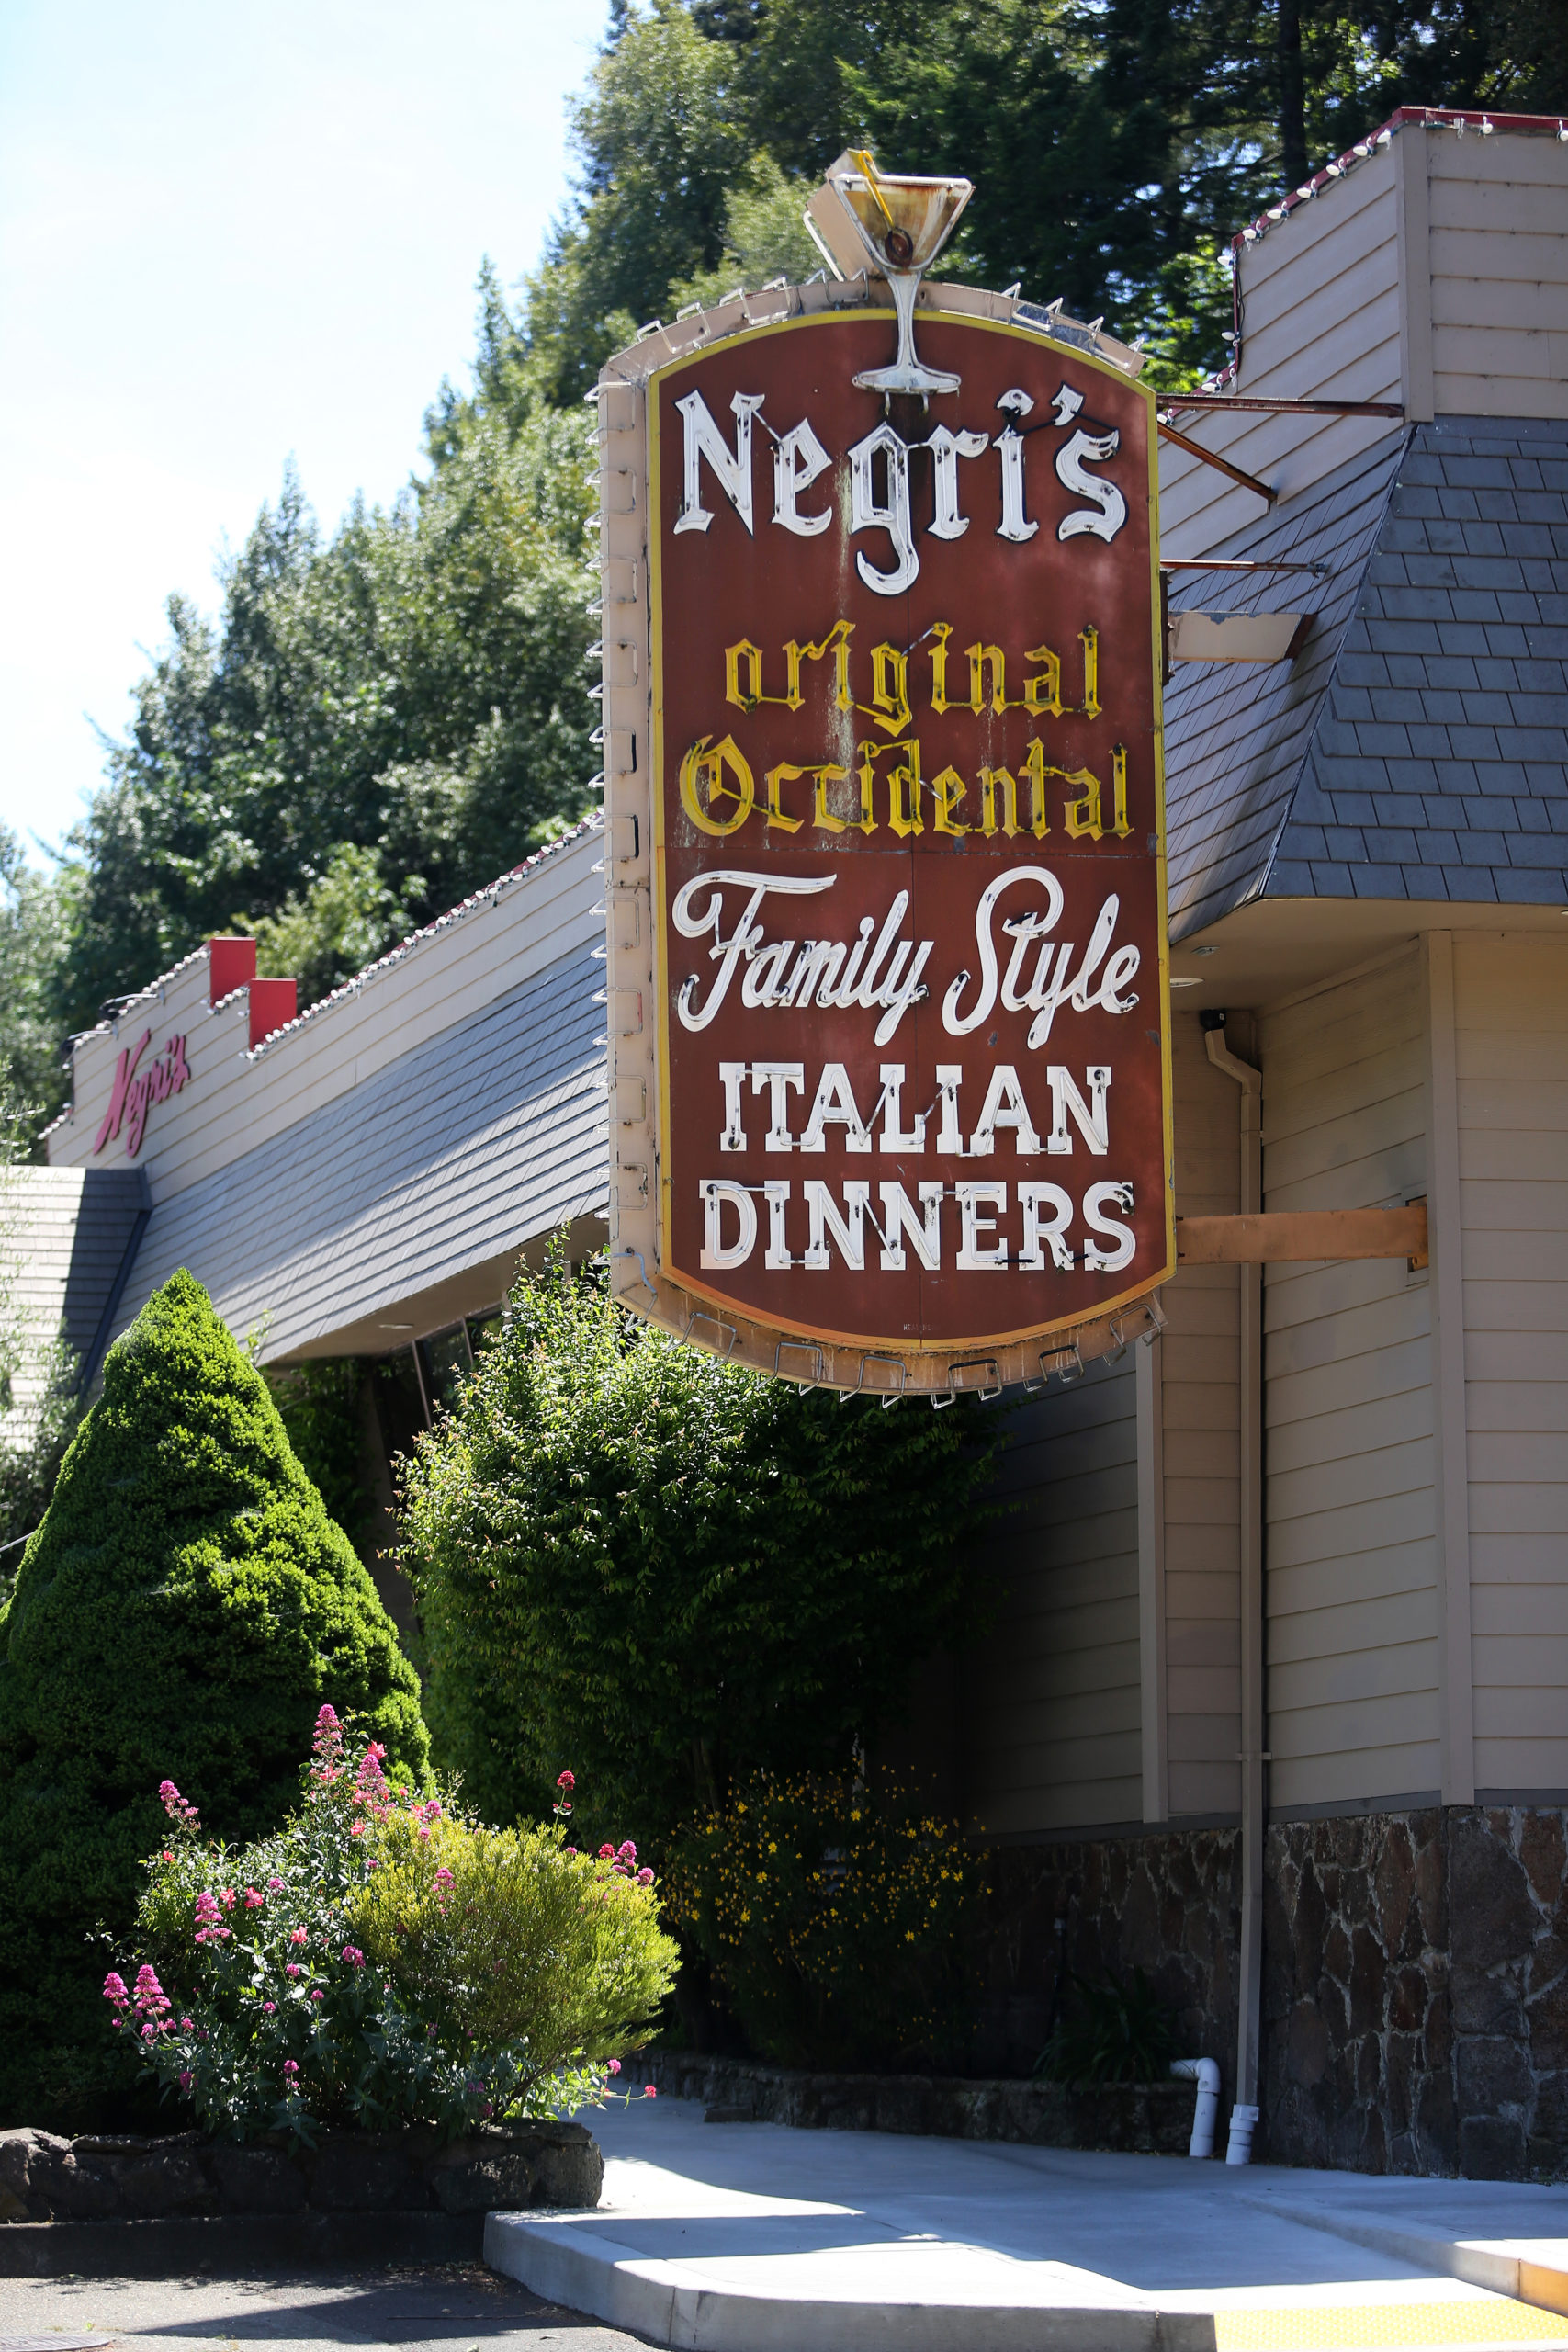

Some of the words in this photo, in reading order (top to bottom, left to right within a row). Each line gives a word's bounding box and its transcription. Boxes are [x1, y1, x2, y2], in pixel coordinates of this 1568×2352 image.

[673, 381, 1128, 595] Negri's
[725, 620, 1102, 736] original
[680, 734, 1134, 840] Occidental
[672, 870, 934, 1046] Family
[942, 865, 1140, 1049] Style
[93, 1028, 191, 1158] Negri's
[719, 1062, 1111, 1157] ITALIAN
[699, 1180, 1136, 1272] DINNERS
